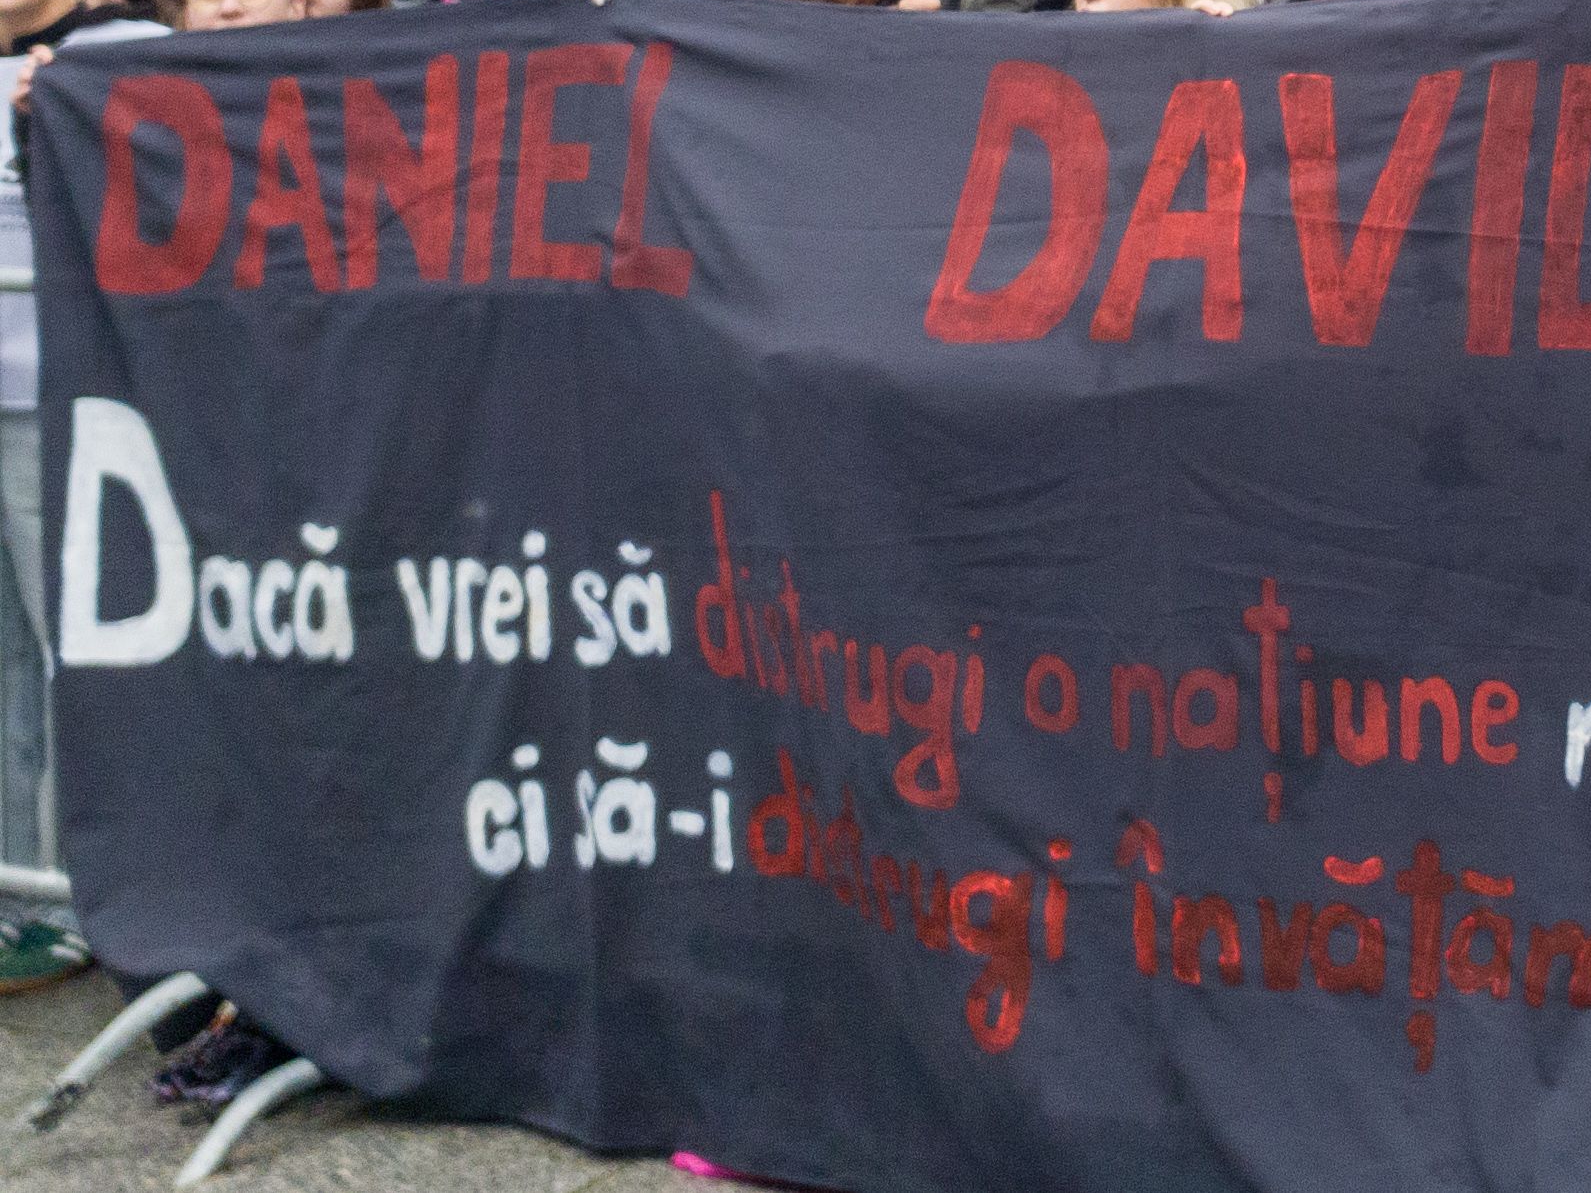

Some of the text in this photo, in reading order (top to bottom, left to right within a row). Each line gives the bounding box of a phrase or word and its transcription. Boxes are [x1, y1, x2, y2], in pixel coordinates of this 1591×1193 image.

[95, 41, 694, 298] DANIEL
[61, 396, 354, 667] Dacă
[397, 530, 551, 666] vrei
[571, 541, 672, 667] să
[1024, 654, 1080, 733] o
[1111, 576, 1520, 823] națiune
[465, 743, 550, 877] ci
[574, 736, 734, 873] să-i
